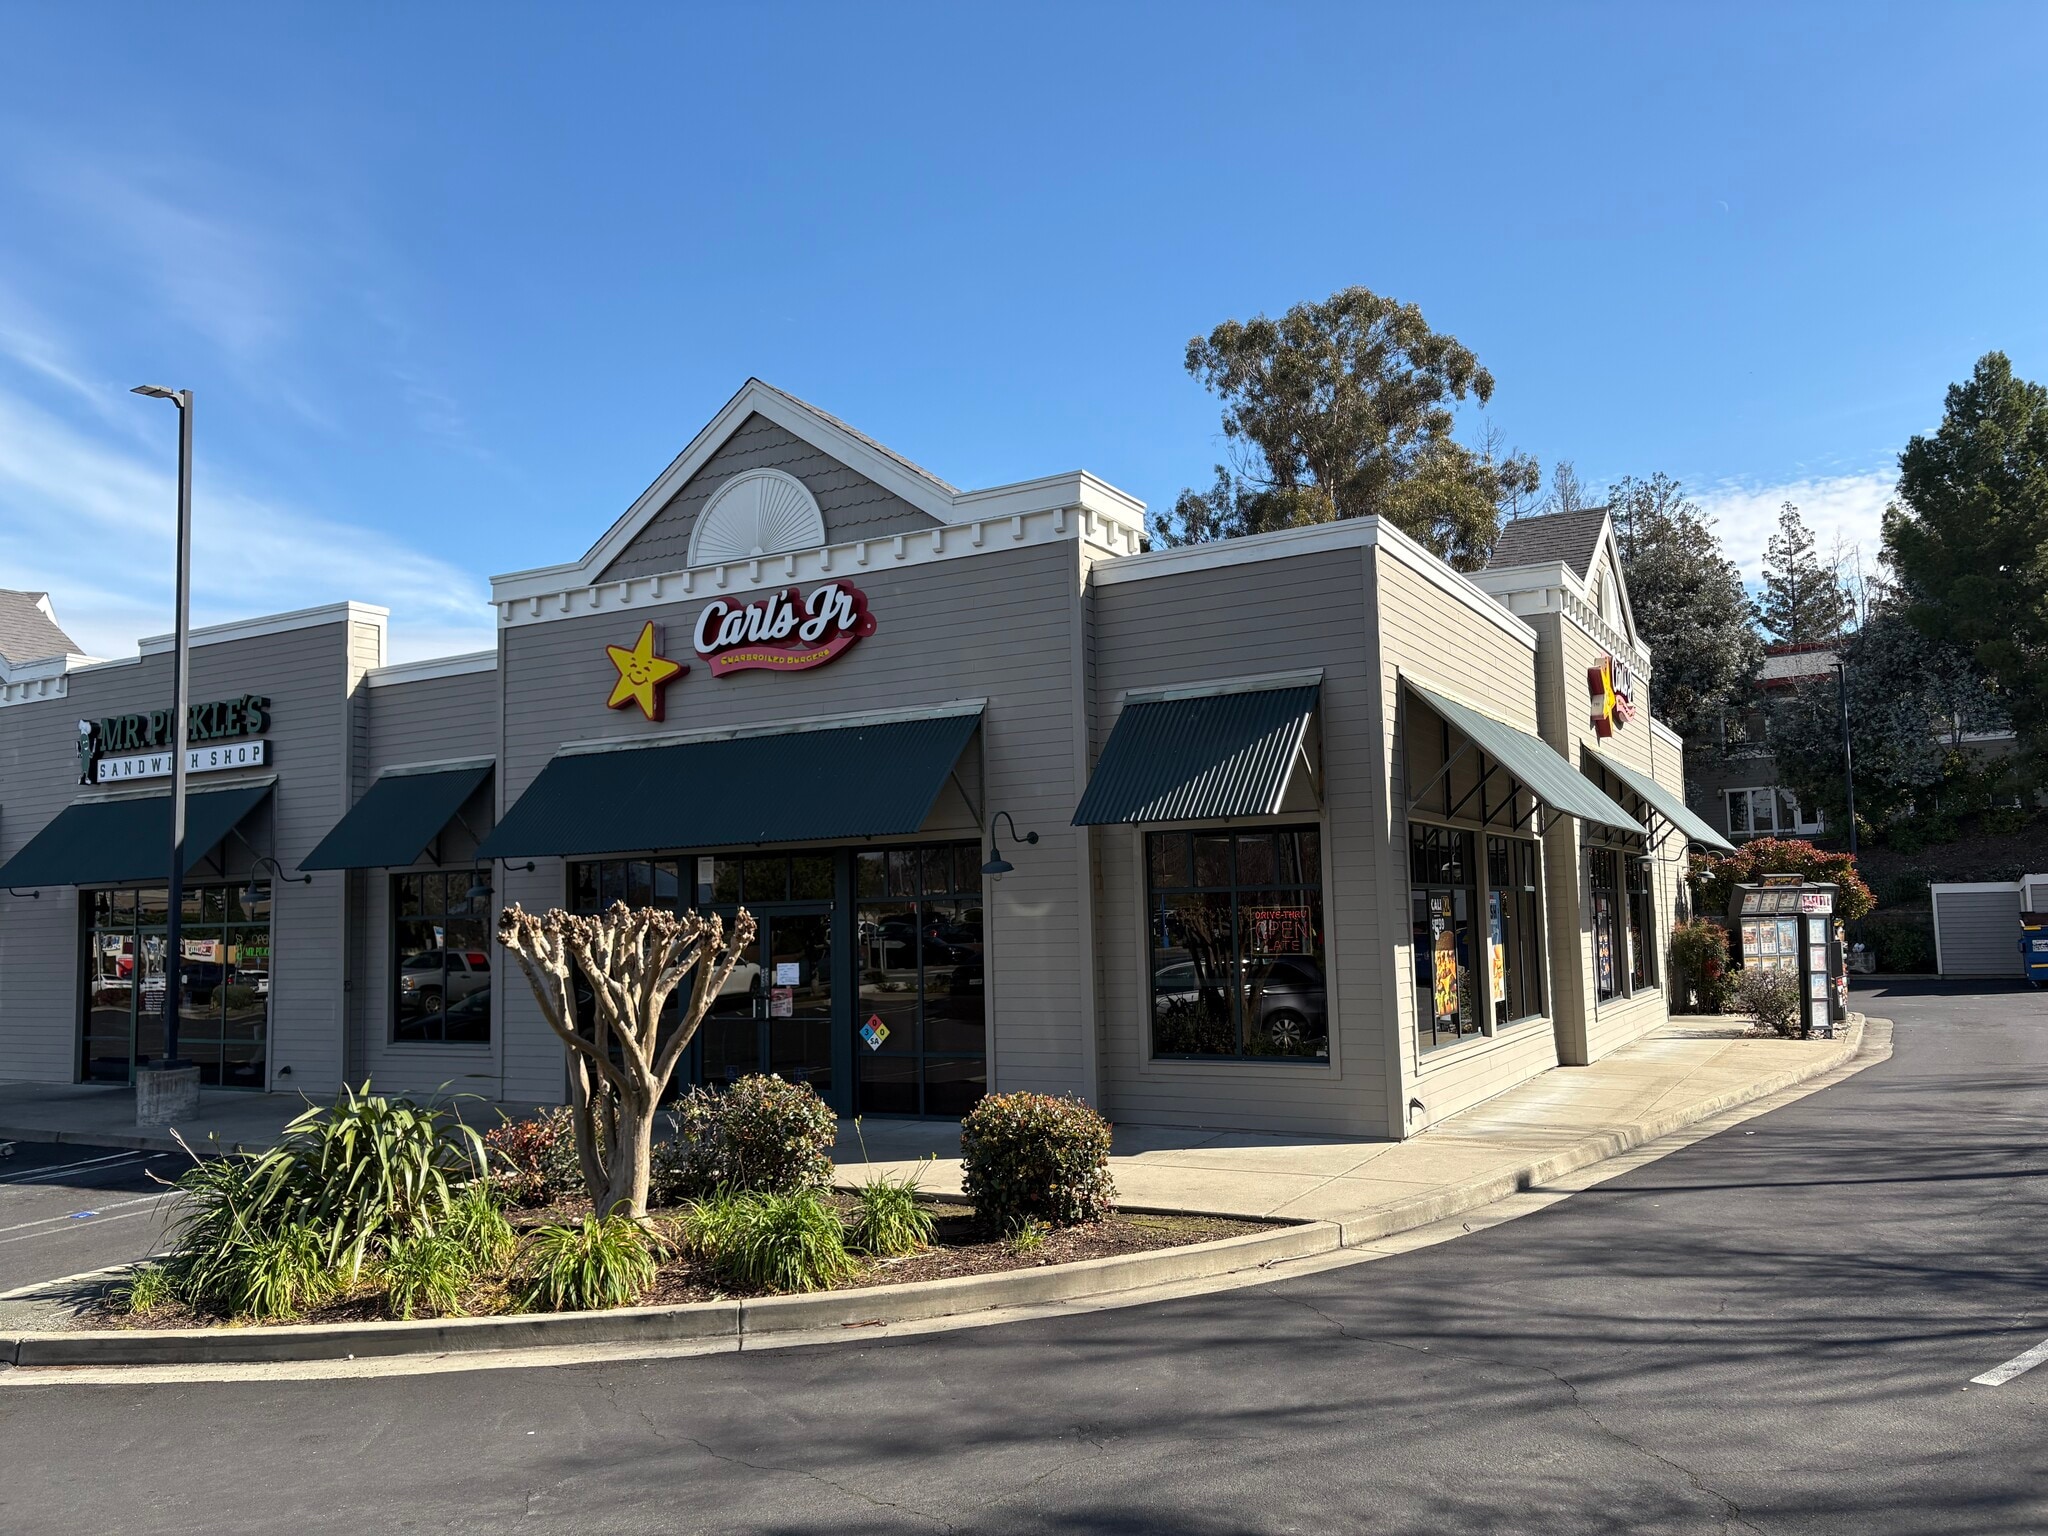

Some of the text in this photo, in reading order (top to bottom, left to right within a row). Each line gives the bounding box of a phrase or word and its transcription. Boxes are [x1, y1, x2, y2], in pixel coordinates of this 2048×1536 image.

[693, 590, 799, 653] Carl's
[720, 649, 830, 665] CHARBROILED BURGERS
[100, 694, 263, 752] MR. PIKLE'S
[100, 746, 260, 778] SANDWIH SHOP
[1255, 910, 1307, 919] DRIVE-THRU
[1256, 920, 1308, 940] OPEN
[251, 934, 269, 945] OPE
[871, 1019, 878, 1027] 0
[864, 1028, 885, 1036] 3 0
[870, 1037, 880, 1045] SA
